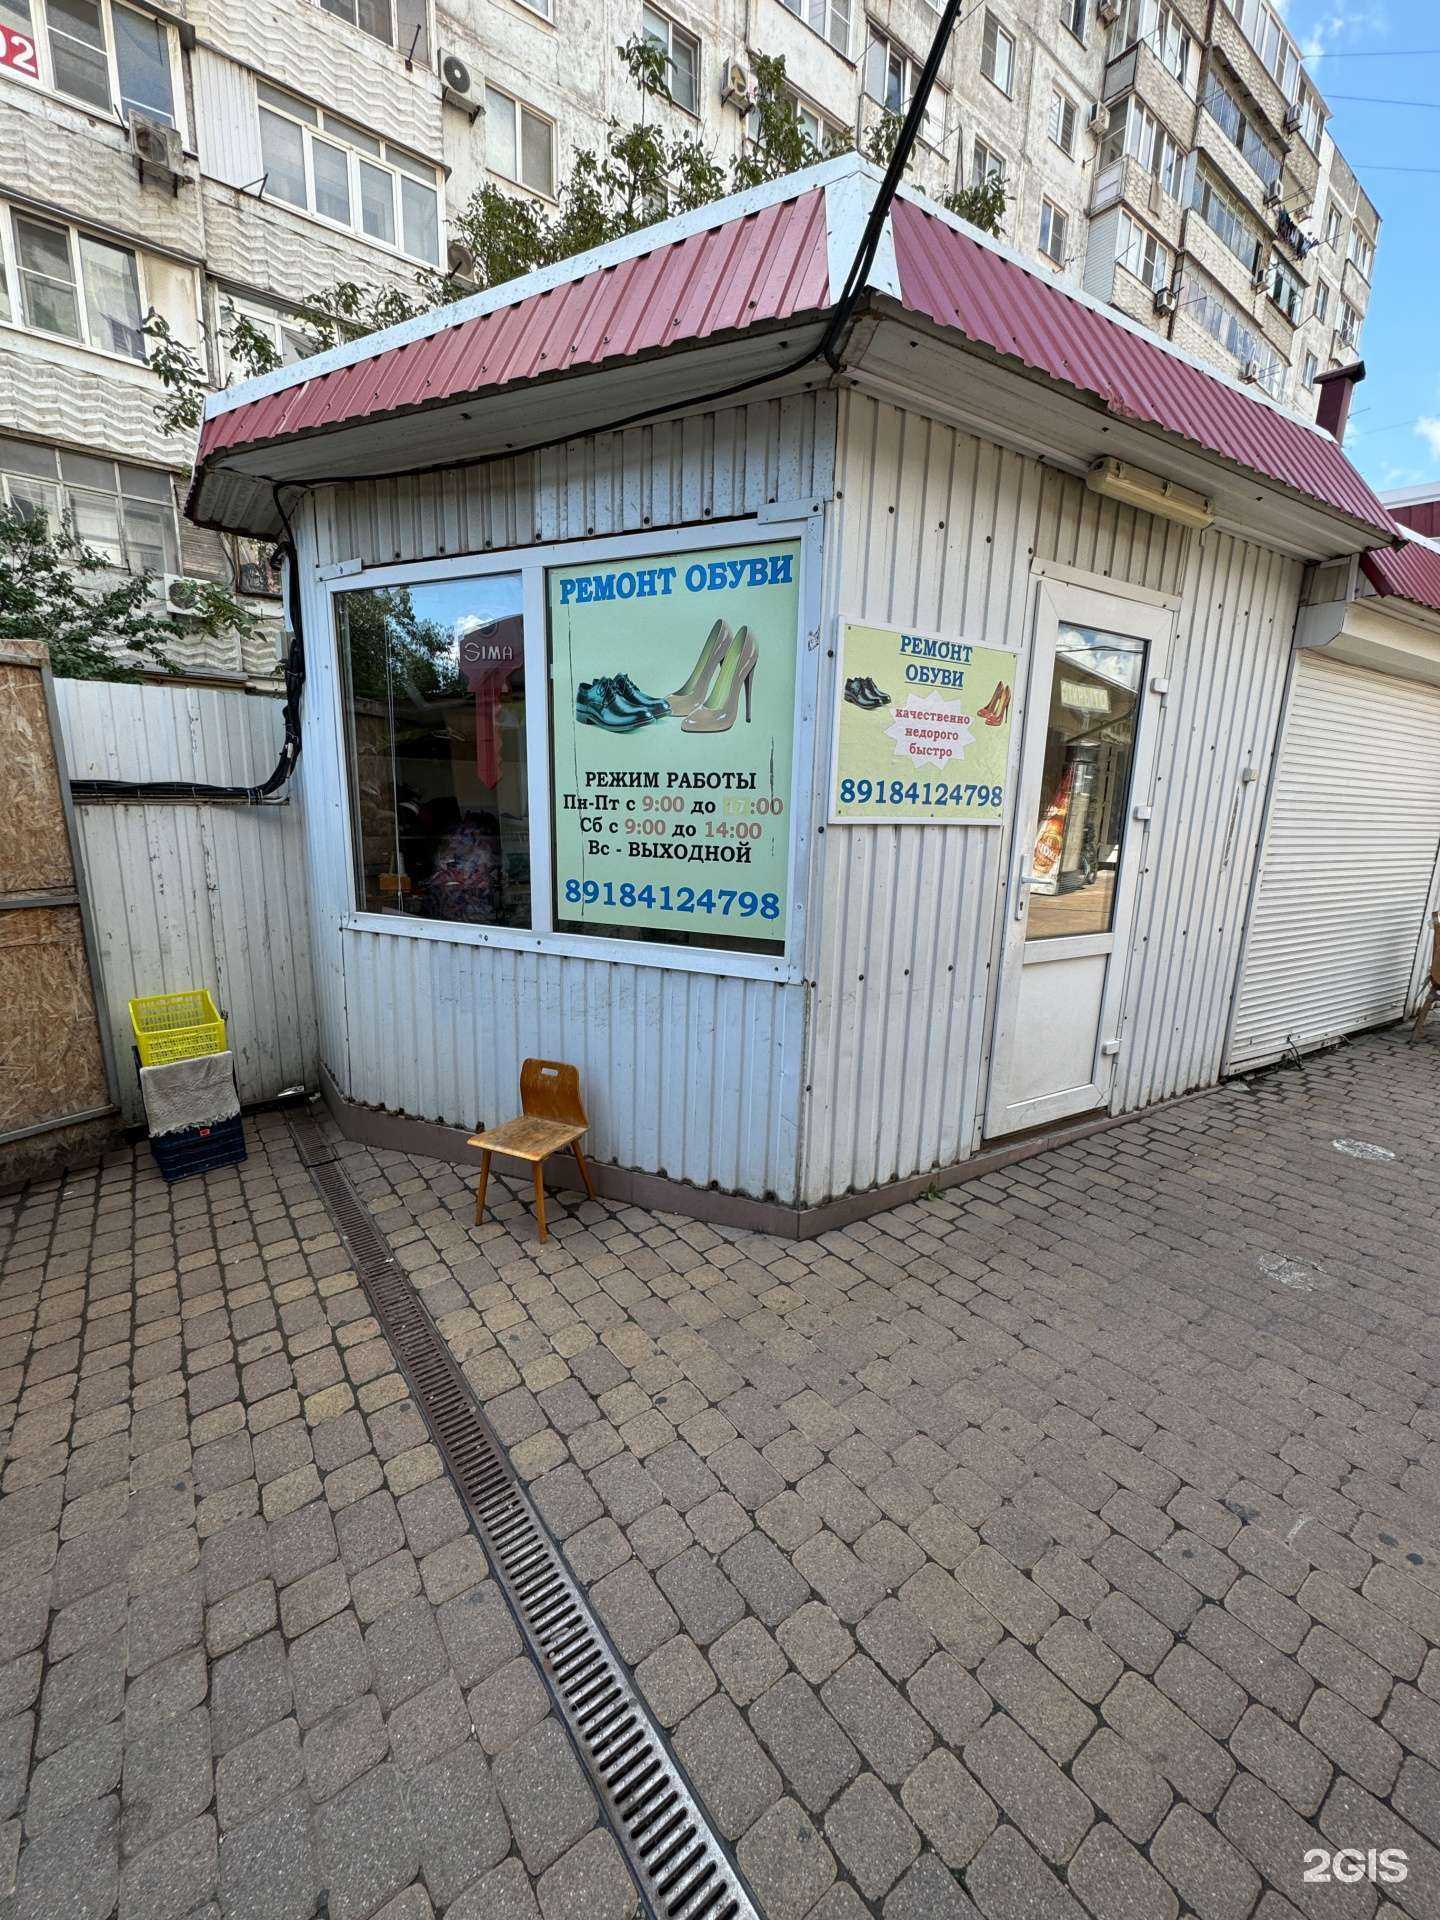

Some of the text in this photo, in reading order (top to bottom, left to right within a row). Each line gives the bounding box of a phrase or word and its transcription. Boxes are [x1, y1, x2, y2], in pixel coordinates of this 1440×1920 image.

[0, 30, 36, 73] 2
[560, 554, 794, 605] РЕМОНТ ОБУВИ
[464, 641, 513, 662] SIMA
[900, 635, 973, 663] РЕМОНТ
[905, 664, 965, 688] ОБУВИ
[895, 708, 971, 725] качественно
[905, 727, 959, 741] недорого
[909, 742, 953, 760] быстро
[585, 771, 757, 790] РЕЖИМ РАБОТЫ
[839, 777, 1004, 807] 89184124798
[563, 794, 620, 811] Пн-Пт
[626, 799, 636, 811] с
[641, 795, 686, 813] 9:00
[691, 800, 717, 815] до
[580, 816, 763, 840] Сб с 9:00 до 14:00
[588, 839, 610, 856] Вс
[628, 842, 752, 863] ВЫХОДНОЙ
[564, 878, 781, 920] 89184124798
